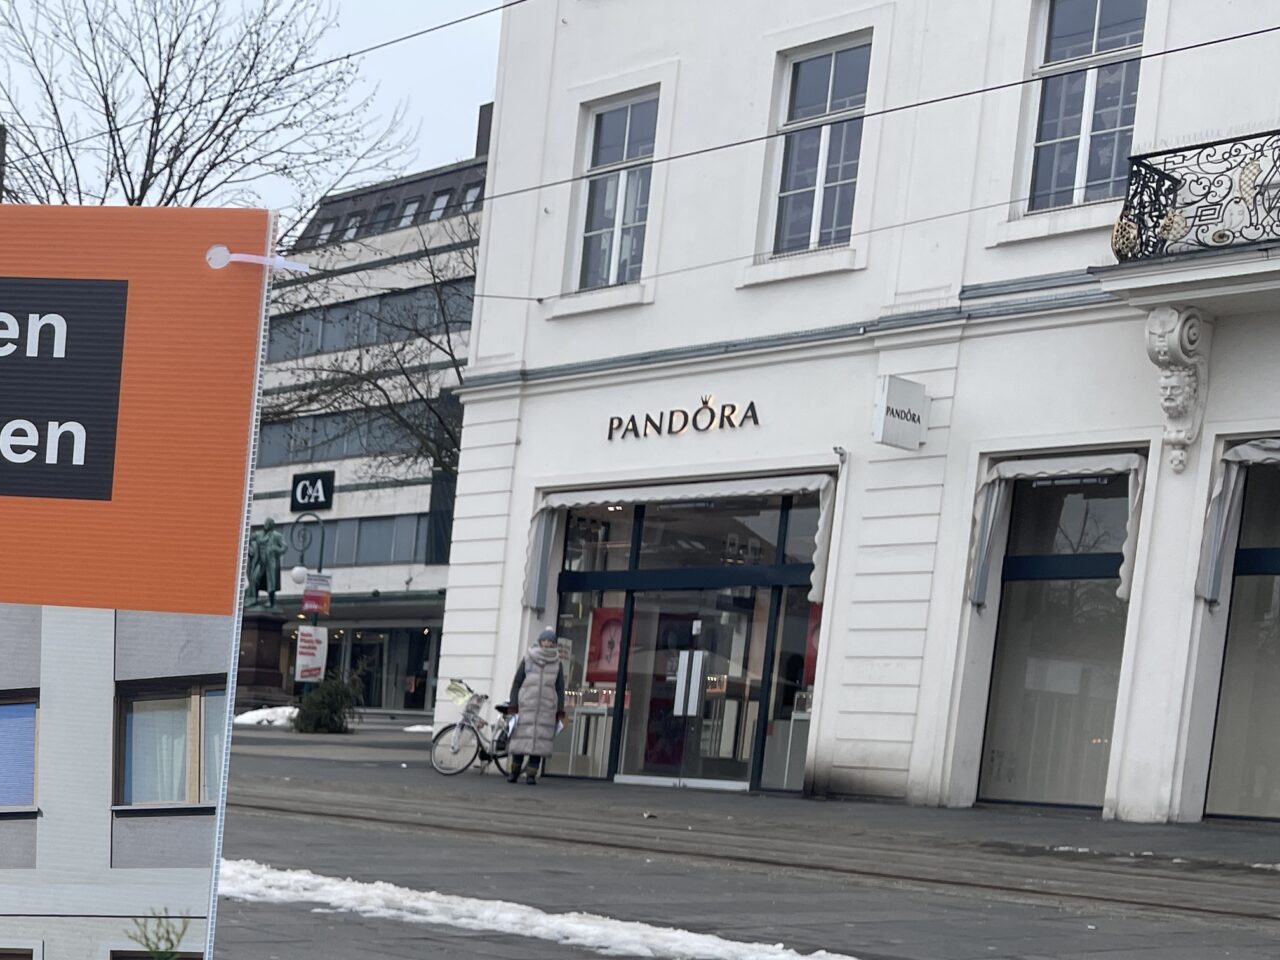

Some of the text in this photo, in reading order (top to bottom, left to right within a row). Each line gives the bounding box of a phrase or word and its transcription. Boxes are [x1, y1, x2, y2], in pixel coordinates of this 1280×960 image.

[608, 398, 760, 441] PANDORA
[886, 406, 921, 425] PANDORA
[296, 479, 326, 504] C&A
